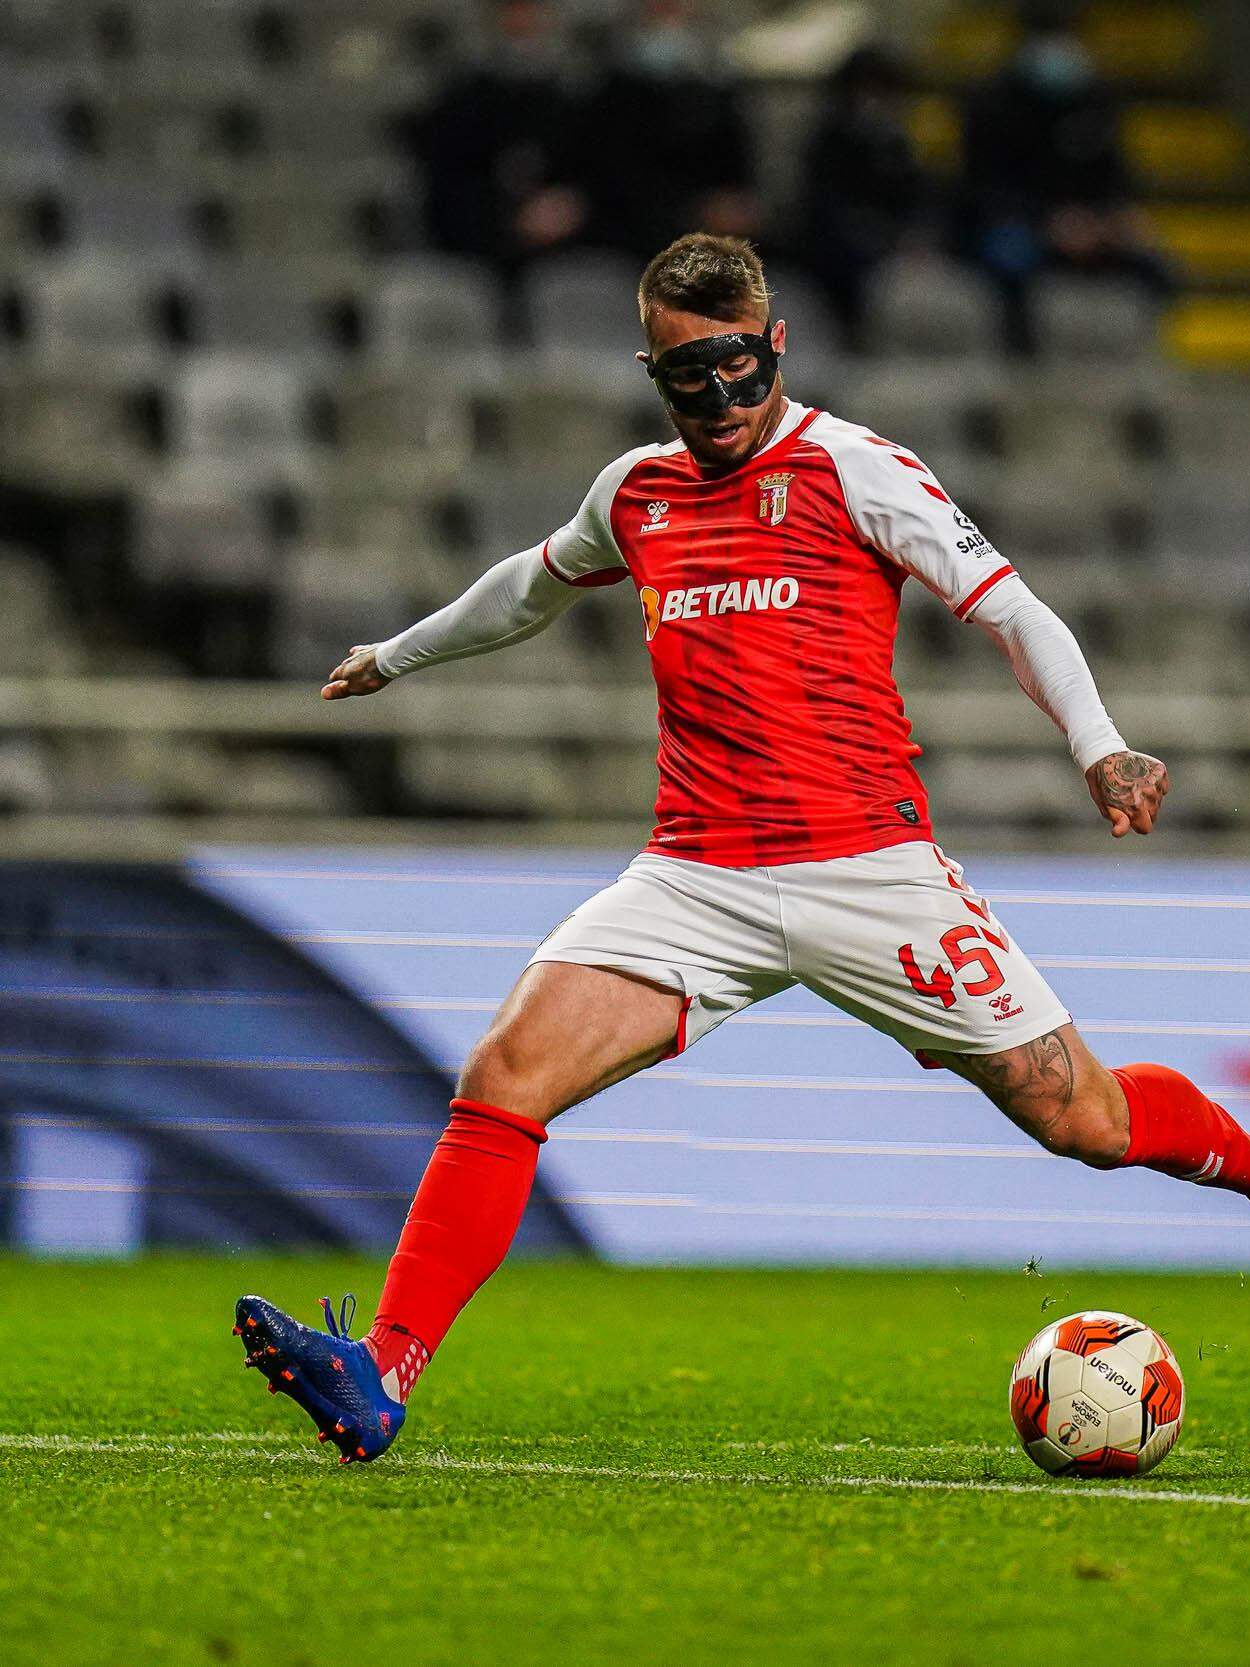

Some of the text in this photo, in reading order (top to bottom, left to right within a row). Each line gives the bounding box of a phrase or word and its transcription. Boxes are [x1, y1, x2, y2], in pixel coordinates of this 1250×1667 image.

[661, 576, 800, 623] BETANO
[897, 924, 1006, 1009] 45
[993, 1005, 1024, 1022] hummel
[1090, 1356, 1137, 1397] molten
[1071, 1399, 1101, 1427] EUROPA
